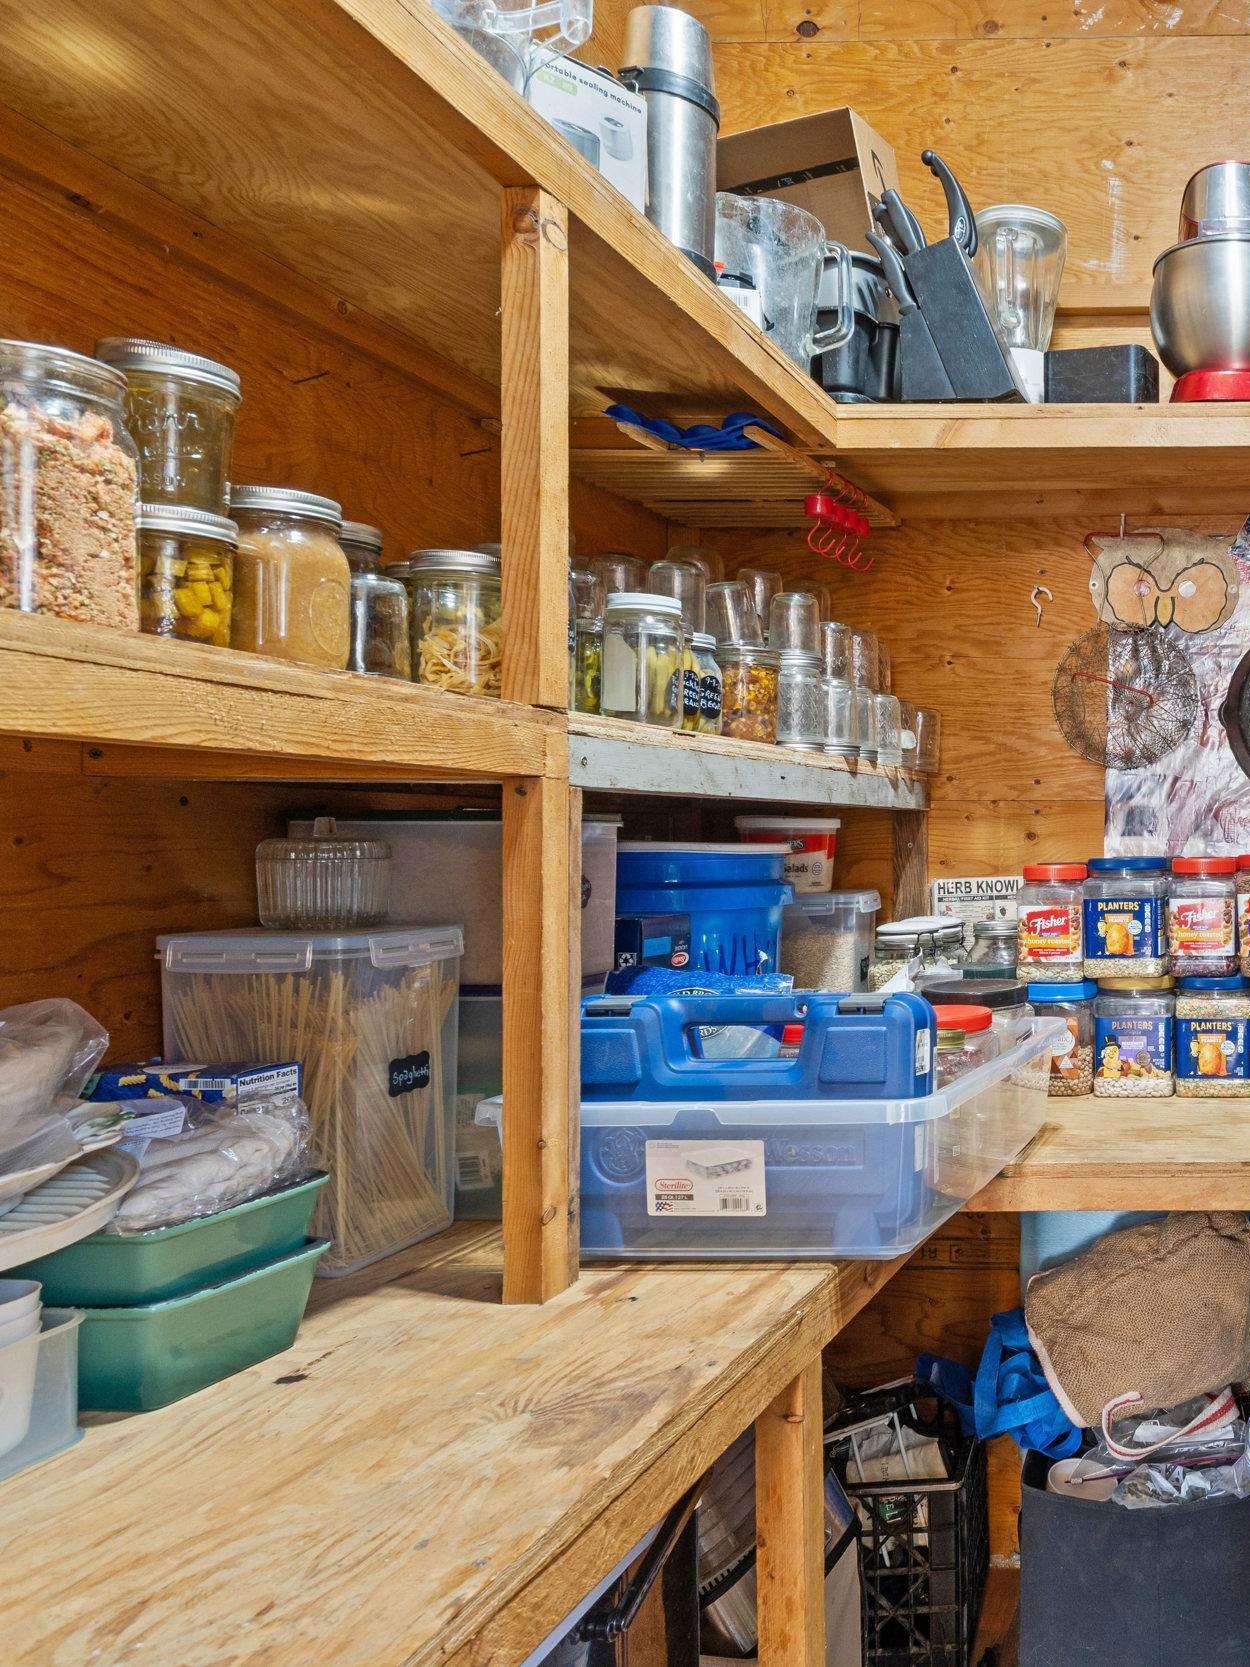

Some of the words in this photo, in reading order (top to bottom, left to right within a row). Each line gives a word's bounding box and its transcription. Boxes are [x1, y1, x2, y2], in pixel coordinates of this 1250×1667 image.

[544, 63, 577, 80] ortable
[579, 78, 608, 97] sealing
[610, 92, 642, 114] machine
[937, 881, 972, 894] HERB
[1098, 901, 1140, 911] PLANTERS
[1181, 908, 1217, 928] Fisher
[1030, 916, 1068, 935] Fisher
[1178, 931, 1198, 940] honey
[1199, 930, 1225, 938] roasted
[1024, 937, 1046, 946] honey
[1047, 936, 1072, 945] roasted
[1112, 1021, 1153, 1030] PLANTERS
[1191, 1021, 1232, 1031] PLANTERS
[240, 1073, 275, 1087] Nutrition
[277, 1068, 298, 1080] Facts
[392, 1063, 430, 1085] Spaghetti
[659, 1181, 689, 1190] Sterilite
